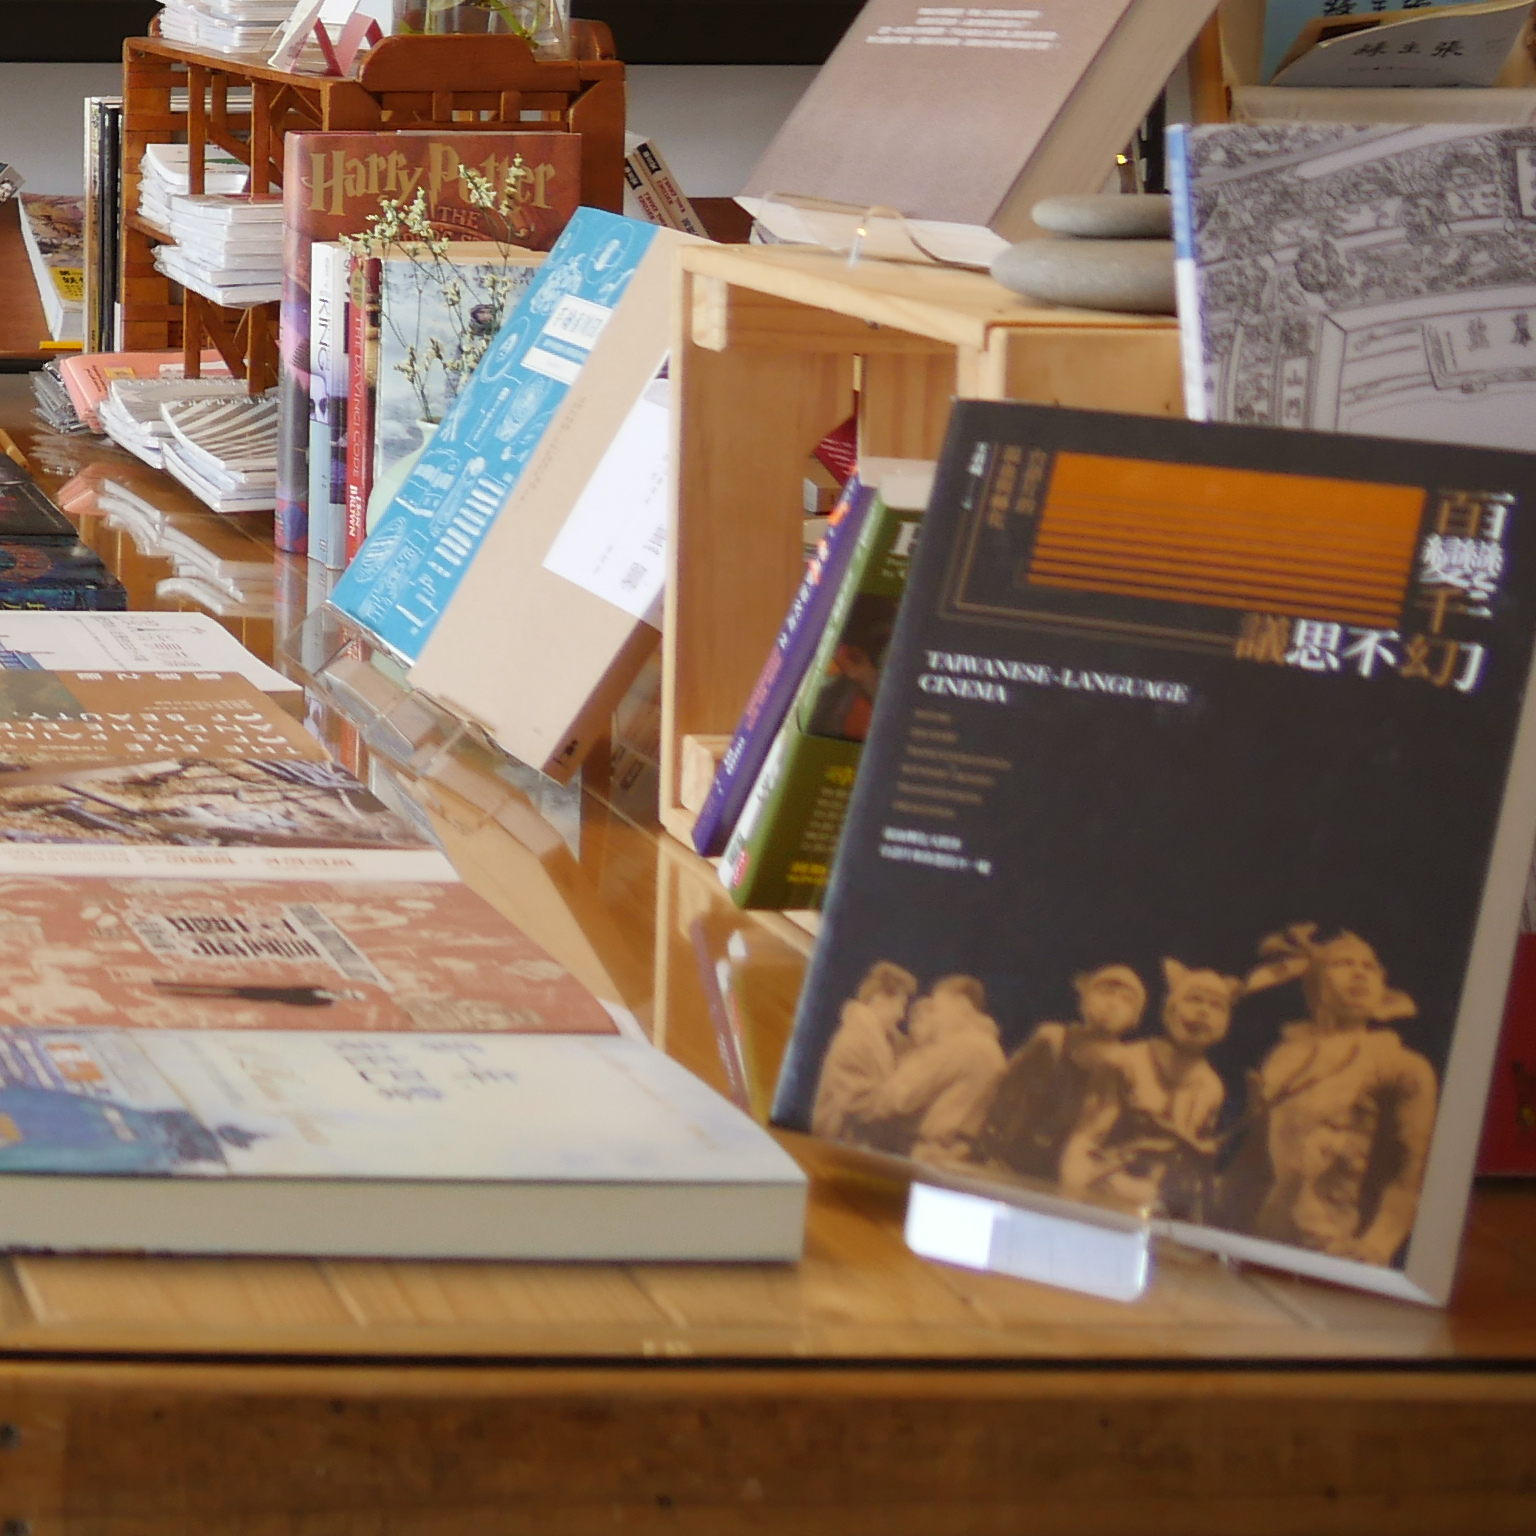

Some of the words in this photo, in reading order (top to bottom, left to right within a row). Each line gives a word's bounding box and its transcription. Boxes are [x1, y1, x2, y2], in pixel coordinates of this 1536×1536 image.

[300, 146, 423, 216] Harry
[429, 141, 557, 218] Potter
[438, 207, 482, 227] THE
[317, 298, 331, 373] KING
[352, 317, 365, 351] THE
[352, 353, 364, 378] DA
[351, 381, 364, 431] VINCI
[351, 432, 364, 477] CODE
[918, 672, 1009, 705] CINEMA
[85, 722, 160, 732] THE
[184, 722, 274, 732] AND
[210, 713, 265, 723] OF
[125, 742, 200, 754] EYE
[134, 733, 210, 743] THE
[233, 734, 288, 745] OF
[226, 744, 302, 755] THE
